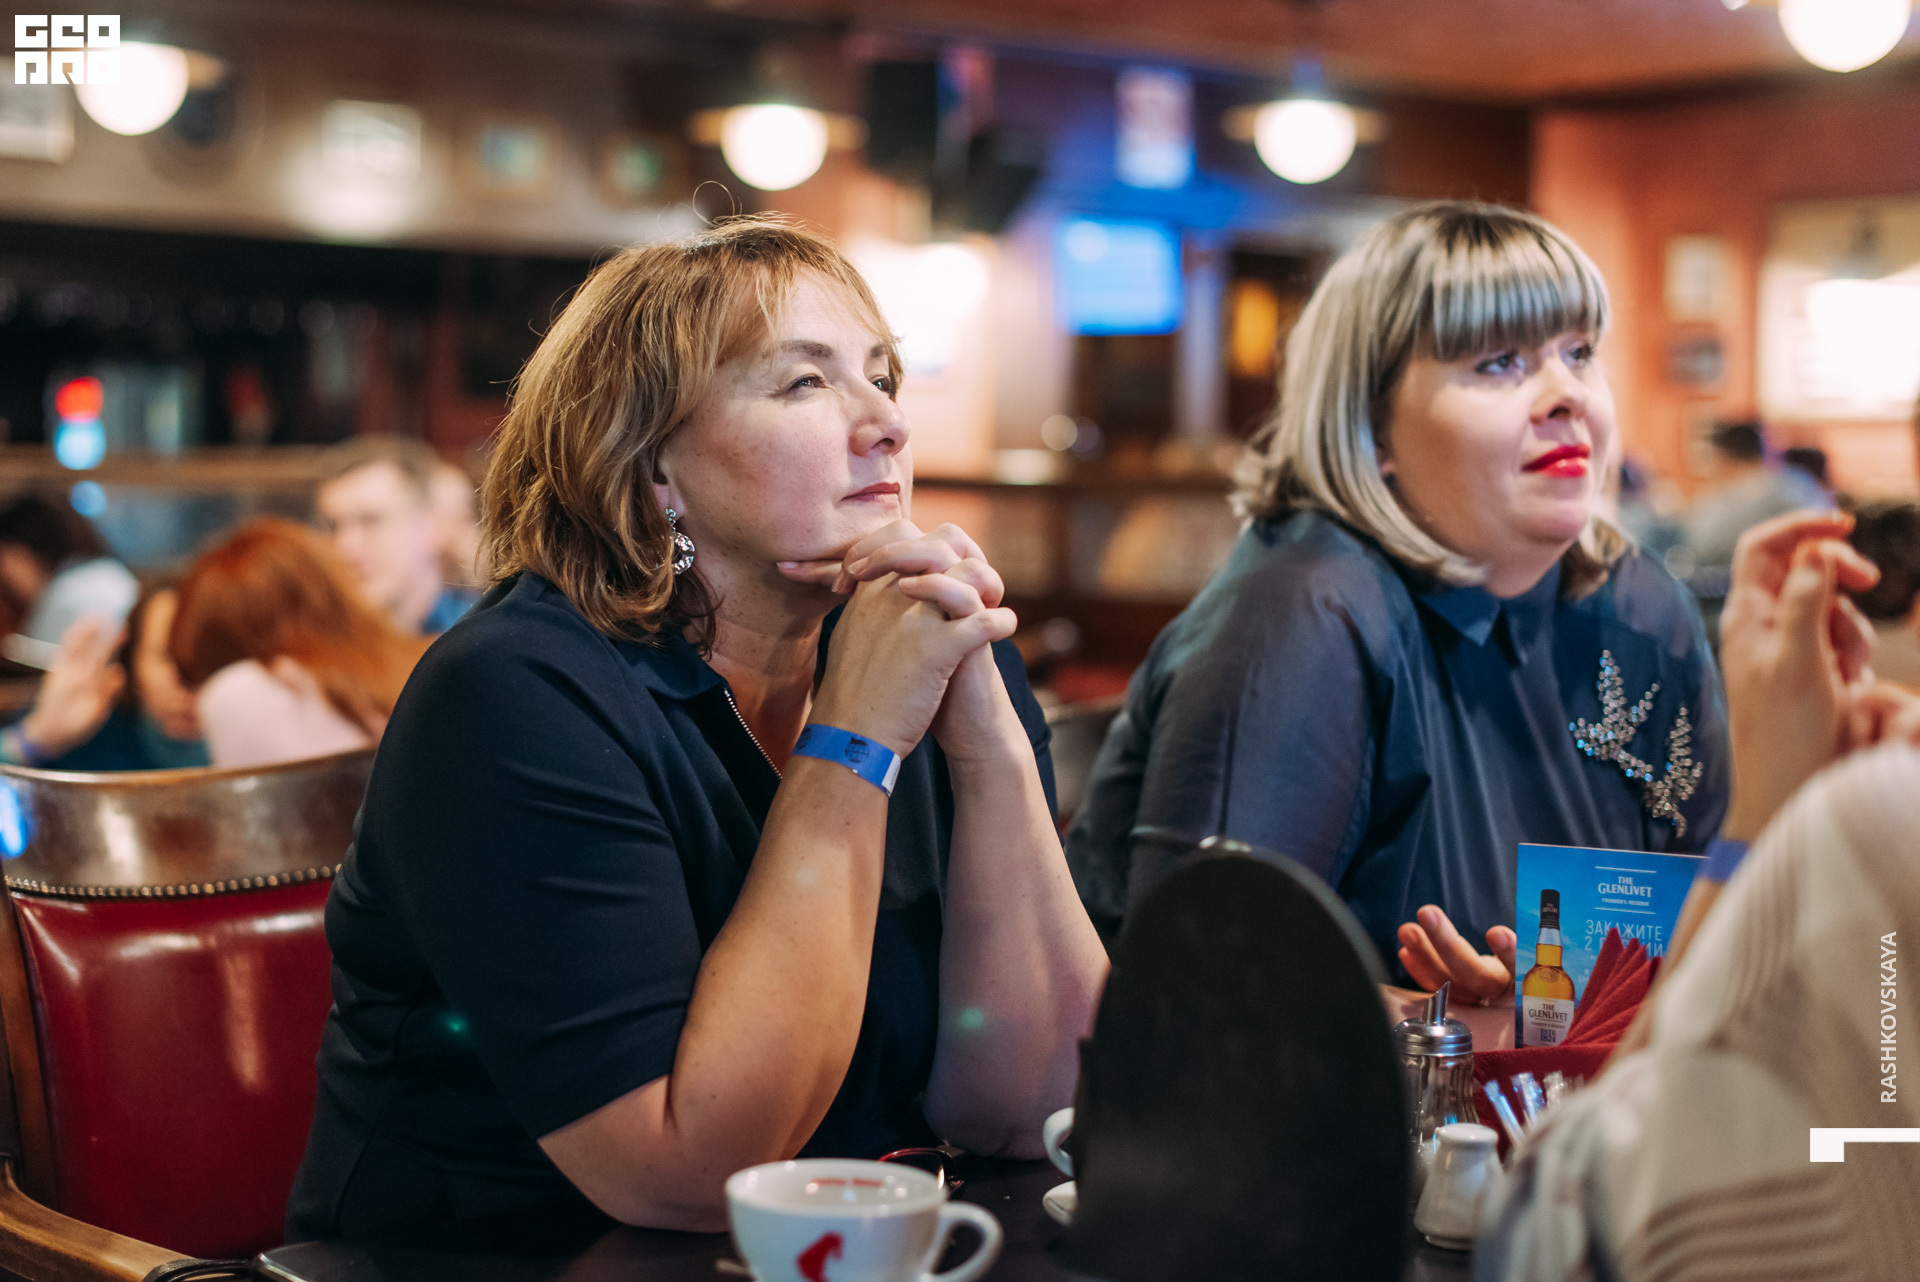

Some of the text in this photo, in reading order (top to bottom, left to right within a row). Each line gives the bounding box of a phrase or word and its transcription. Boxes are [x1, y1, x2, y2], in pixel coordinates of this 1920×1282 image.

[1618, 876, 1633, 885] THE
[1598, 883, 1652, 897] GLENLIVET
[1584, 936, 1593, 951] 2
[1529, 1009, 1568, 1021] GLENLIVET
